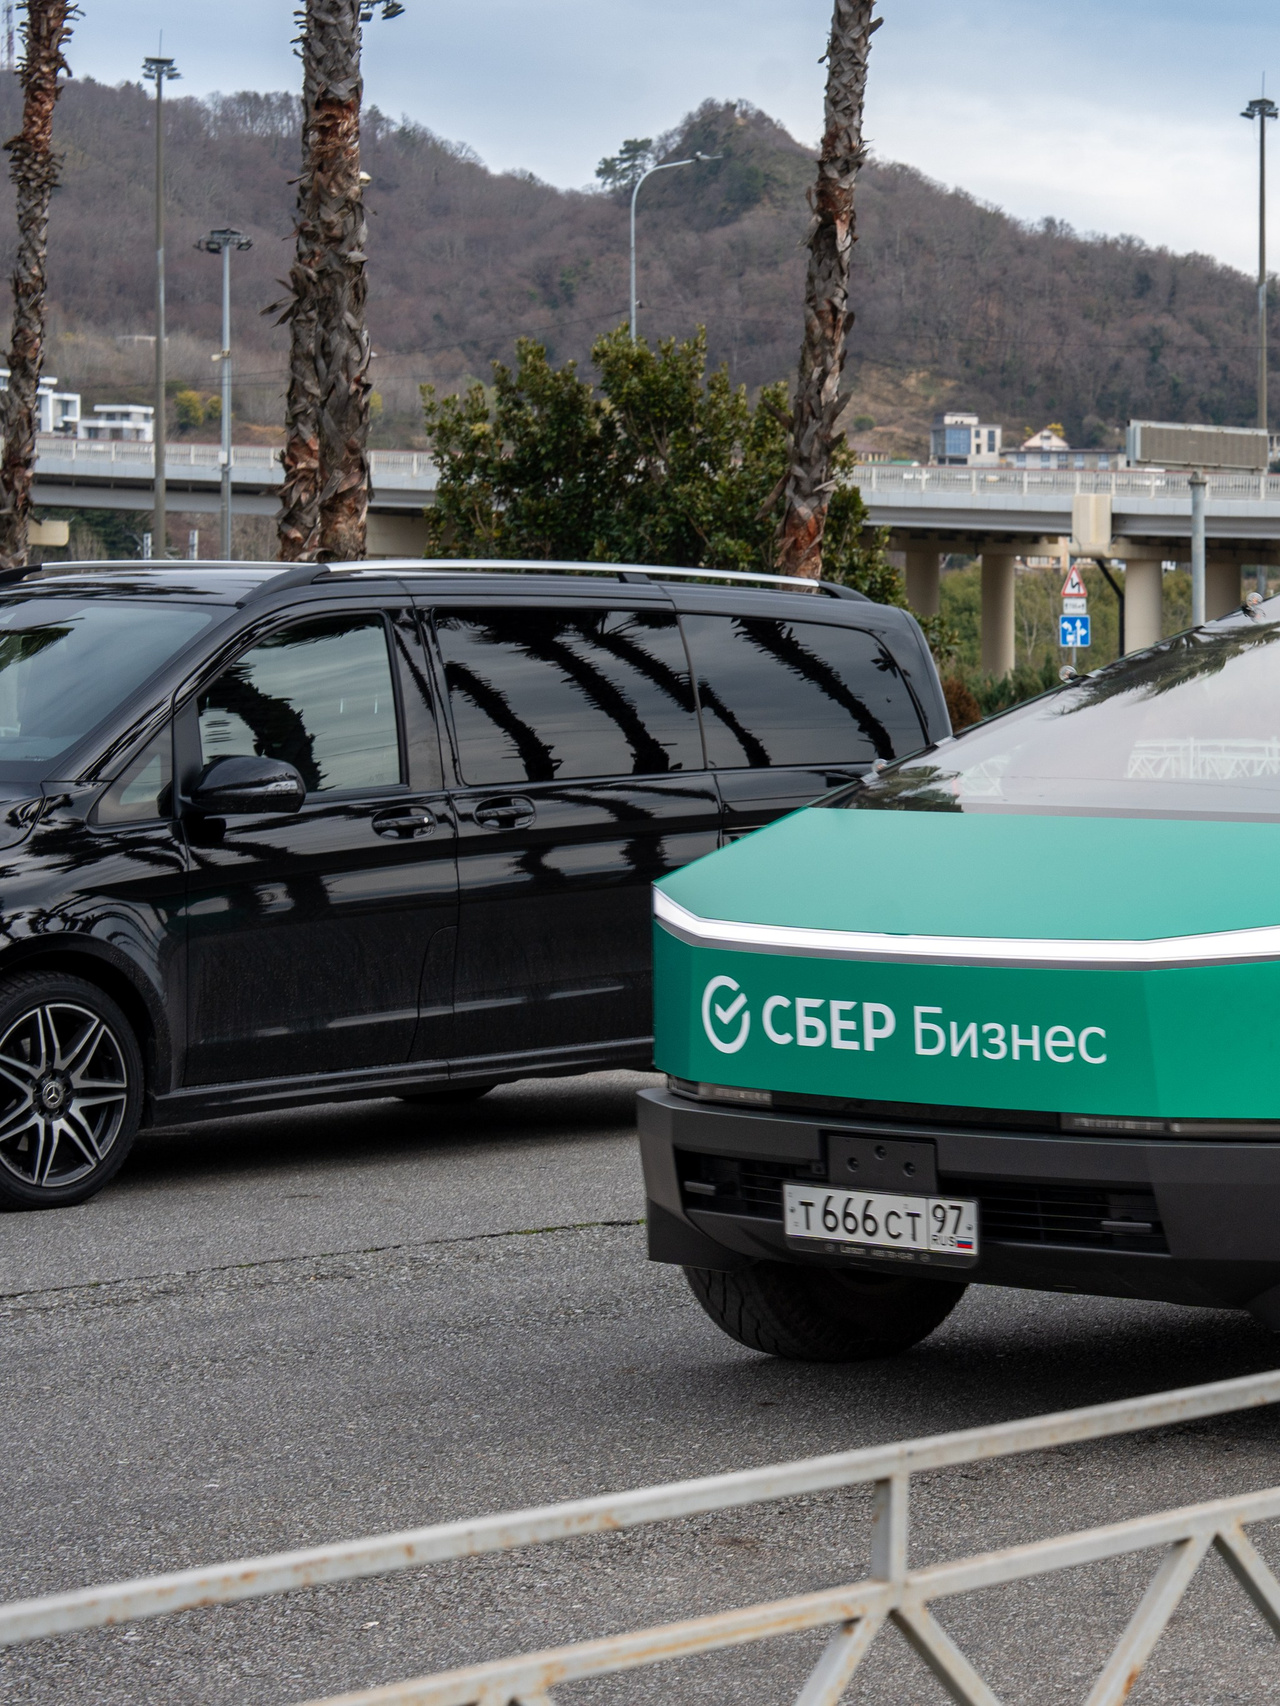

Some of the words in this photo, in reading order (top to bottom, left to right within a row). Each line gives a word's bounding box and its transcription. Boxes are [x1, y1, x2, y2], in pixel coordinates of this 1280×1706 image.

[762, 995, 896, 1052] СБЕР
[913, 1005, 1107, 1064] Бизнес
[931, 1234, 957, 1247] RUS
